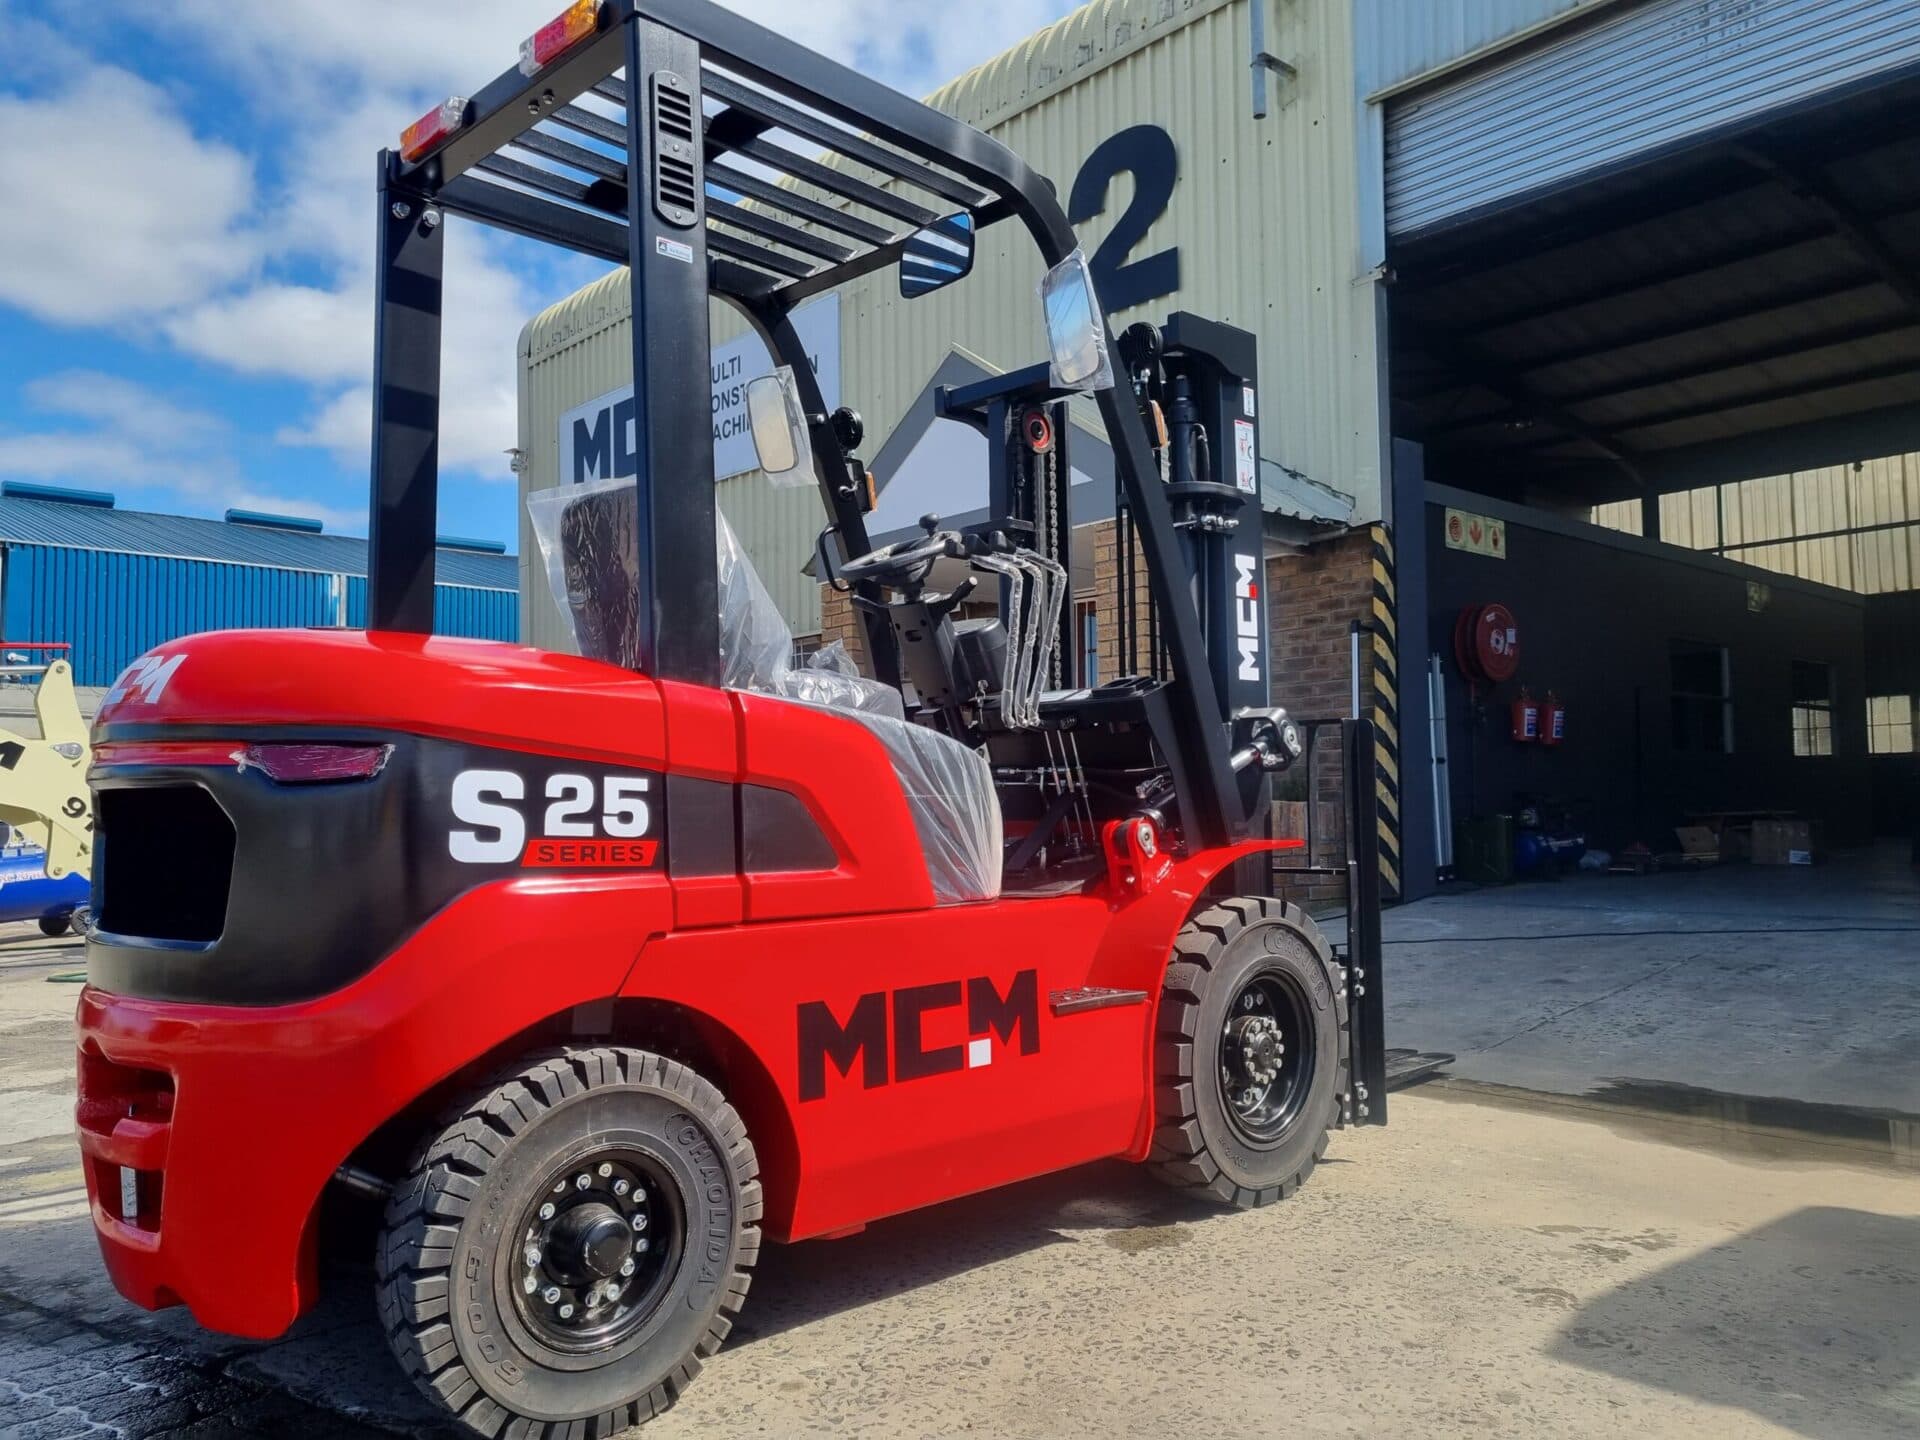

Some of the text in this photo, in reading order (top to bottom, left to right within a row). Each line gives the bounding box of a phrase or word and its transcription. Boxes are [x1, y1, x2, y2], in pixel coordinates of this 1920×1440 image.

[1068, 124, 1179, 315] 2
[711, 355, 741, 384] ULTI
[711, 383, 746, 413] ONST
[573, 397, 636, 485] MC
[713, 414, 749, 440] ACHI
[1234, 554, 1260, 681] MCM
[102, 654, 189, 704] CM
[449, 770, 649, 863] S 25
[538, 844, 644, 863] SERIES
[797, 968, 1040, 1104] MCM
[677, 1125, 728, 1284] CHAOLIDA
